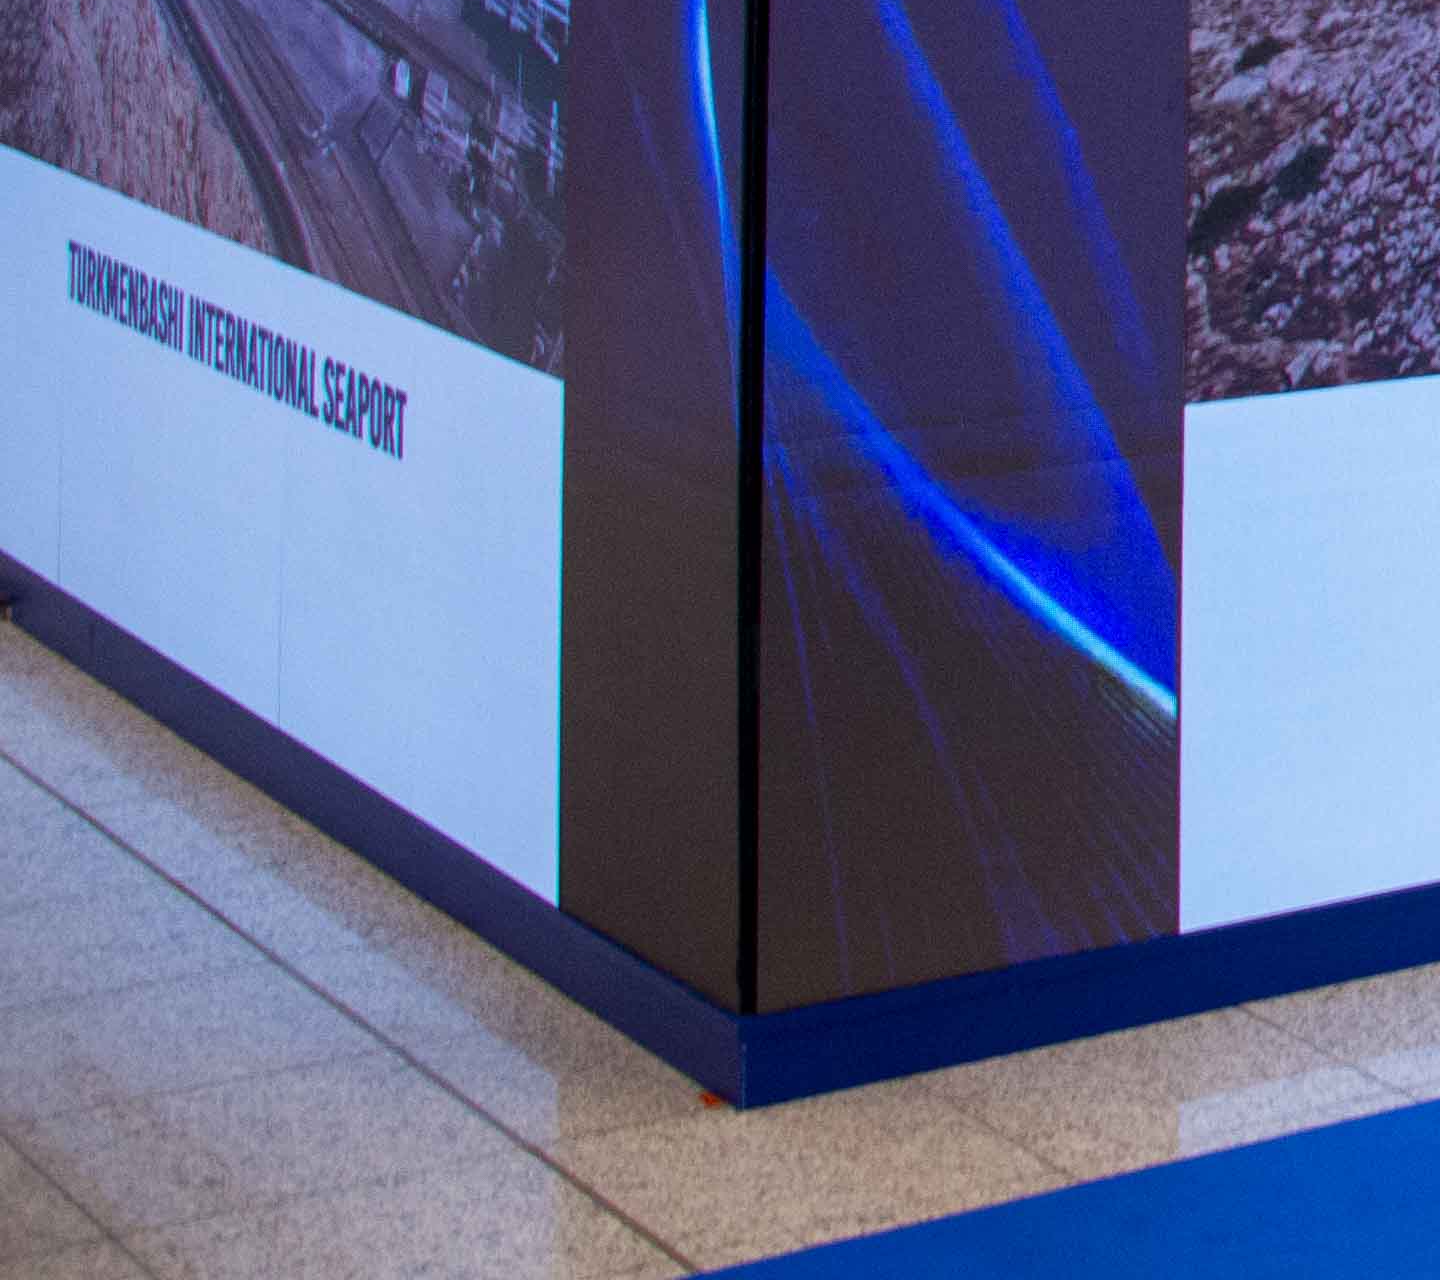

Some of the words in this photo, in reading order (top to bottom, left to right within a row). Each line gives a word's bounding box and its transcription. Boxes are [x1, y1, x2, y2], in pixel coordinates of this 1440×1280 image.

[68, 240, 184, 352] TURKMENBASHI
[188, 295, 319, 419] INTERNATIONAL
[322, 356, 408, 461] SEAPORT
